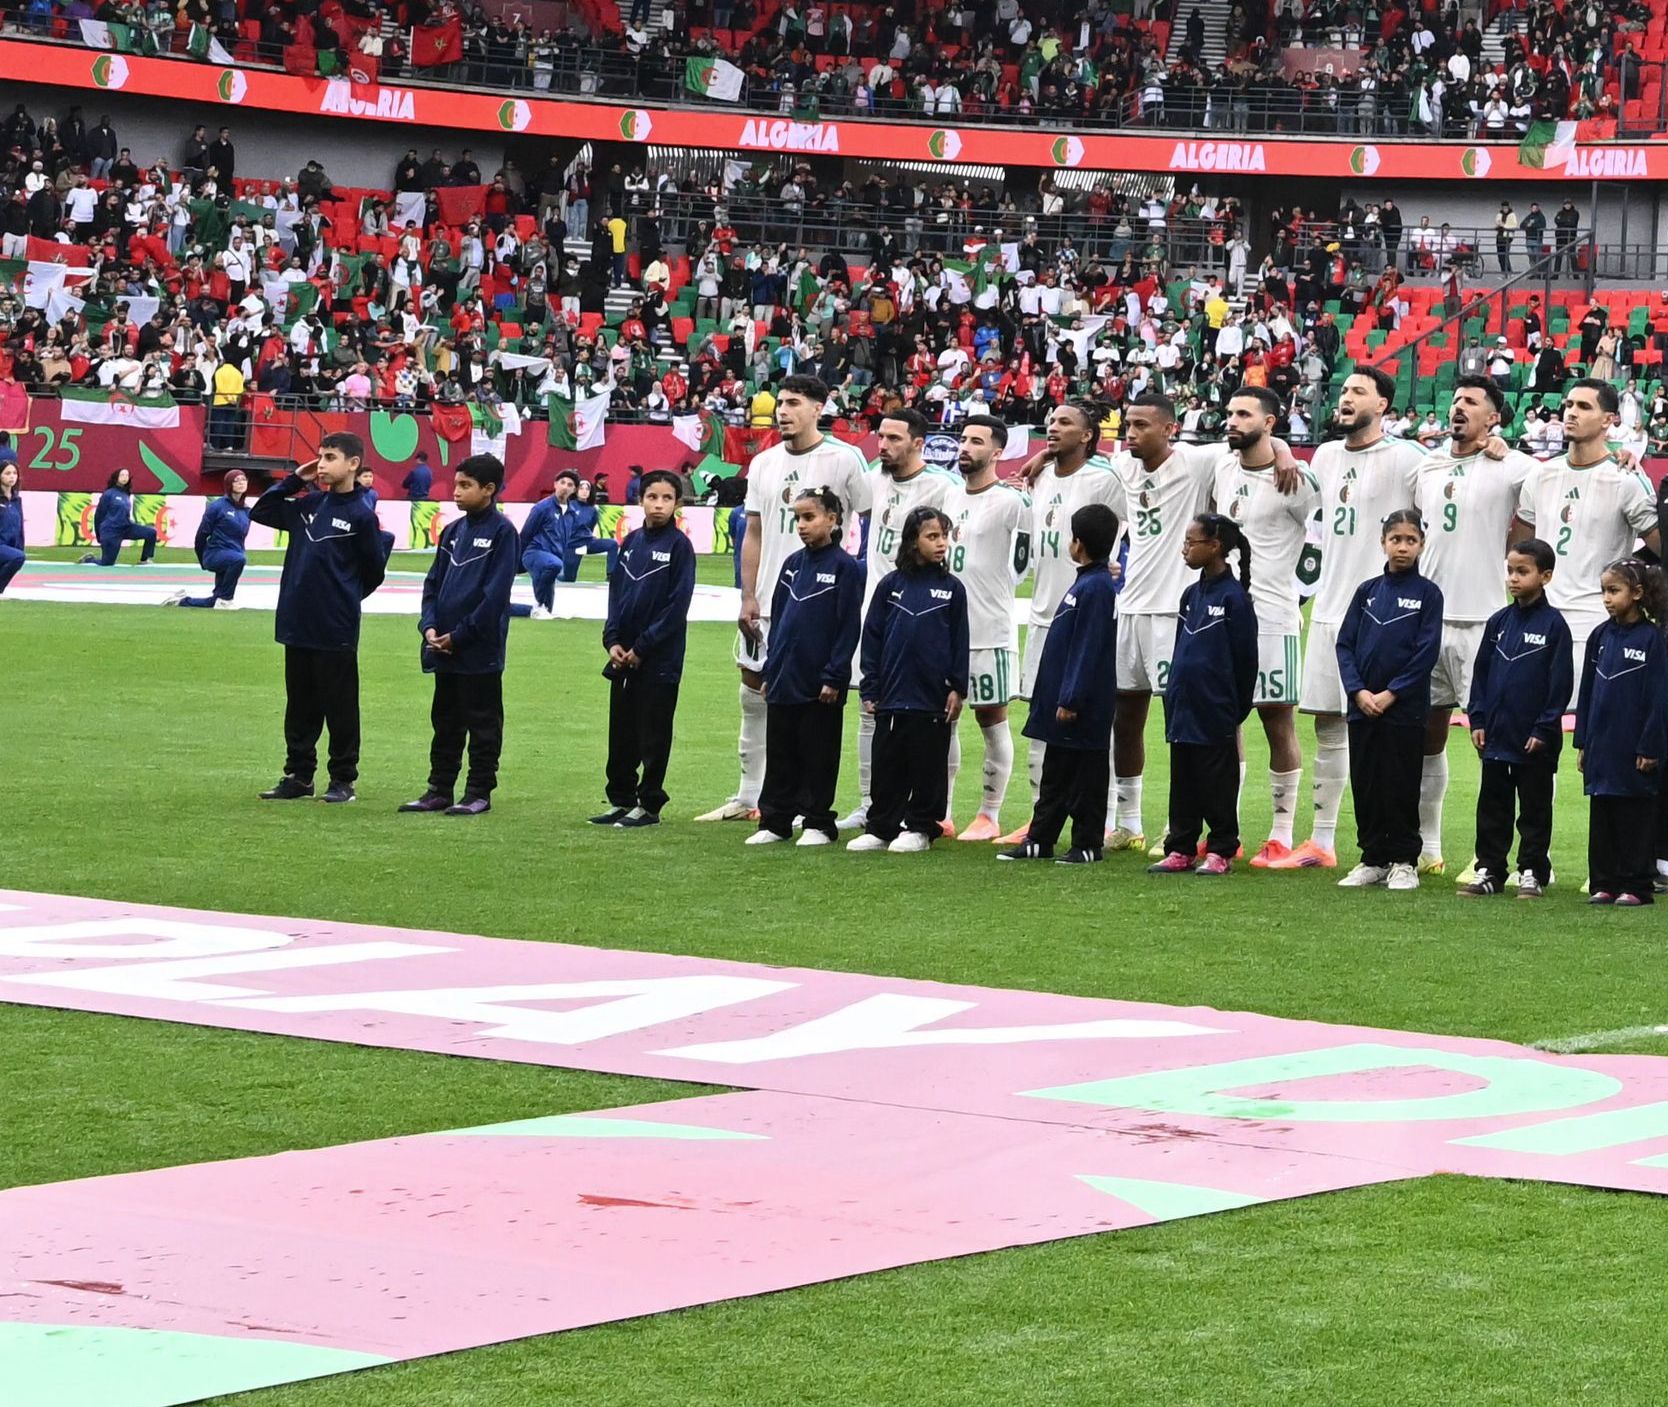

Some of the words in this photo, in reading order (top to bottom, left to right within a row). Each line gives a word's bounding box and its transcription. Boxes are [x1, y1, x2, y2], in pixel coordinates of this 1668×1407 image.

[1169, 142, 1266, 171] ALGERIA
[1564, 148, 1648, 176] ALGERIA
[331, 517, 352, 532] VISA
[1334, 507, 1356, 536] 21
[1443, 503, 1457, 532] 9
[472, 538, 492, 548] VISA
[876, 527, 893, 554] 10
[1041, 531, 1060, 558] 14
[1556, 527, 1572, 556] 2
[651, 550, 671, 561] VISA
[816, 573, 836, 584] VISA
[929, 589, 952, 600] VISA
[1398, 598, 1421, 610] VISA
[1523, 632, 1546, 645] VISA
[1624, 648, 1646, 661] VISA
